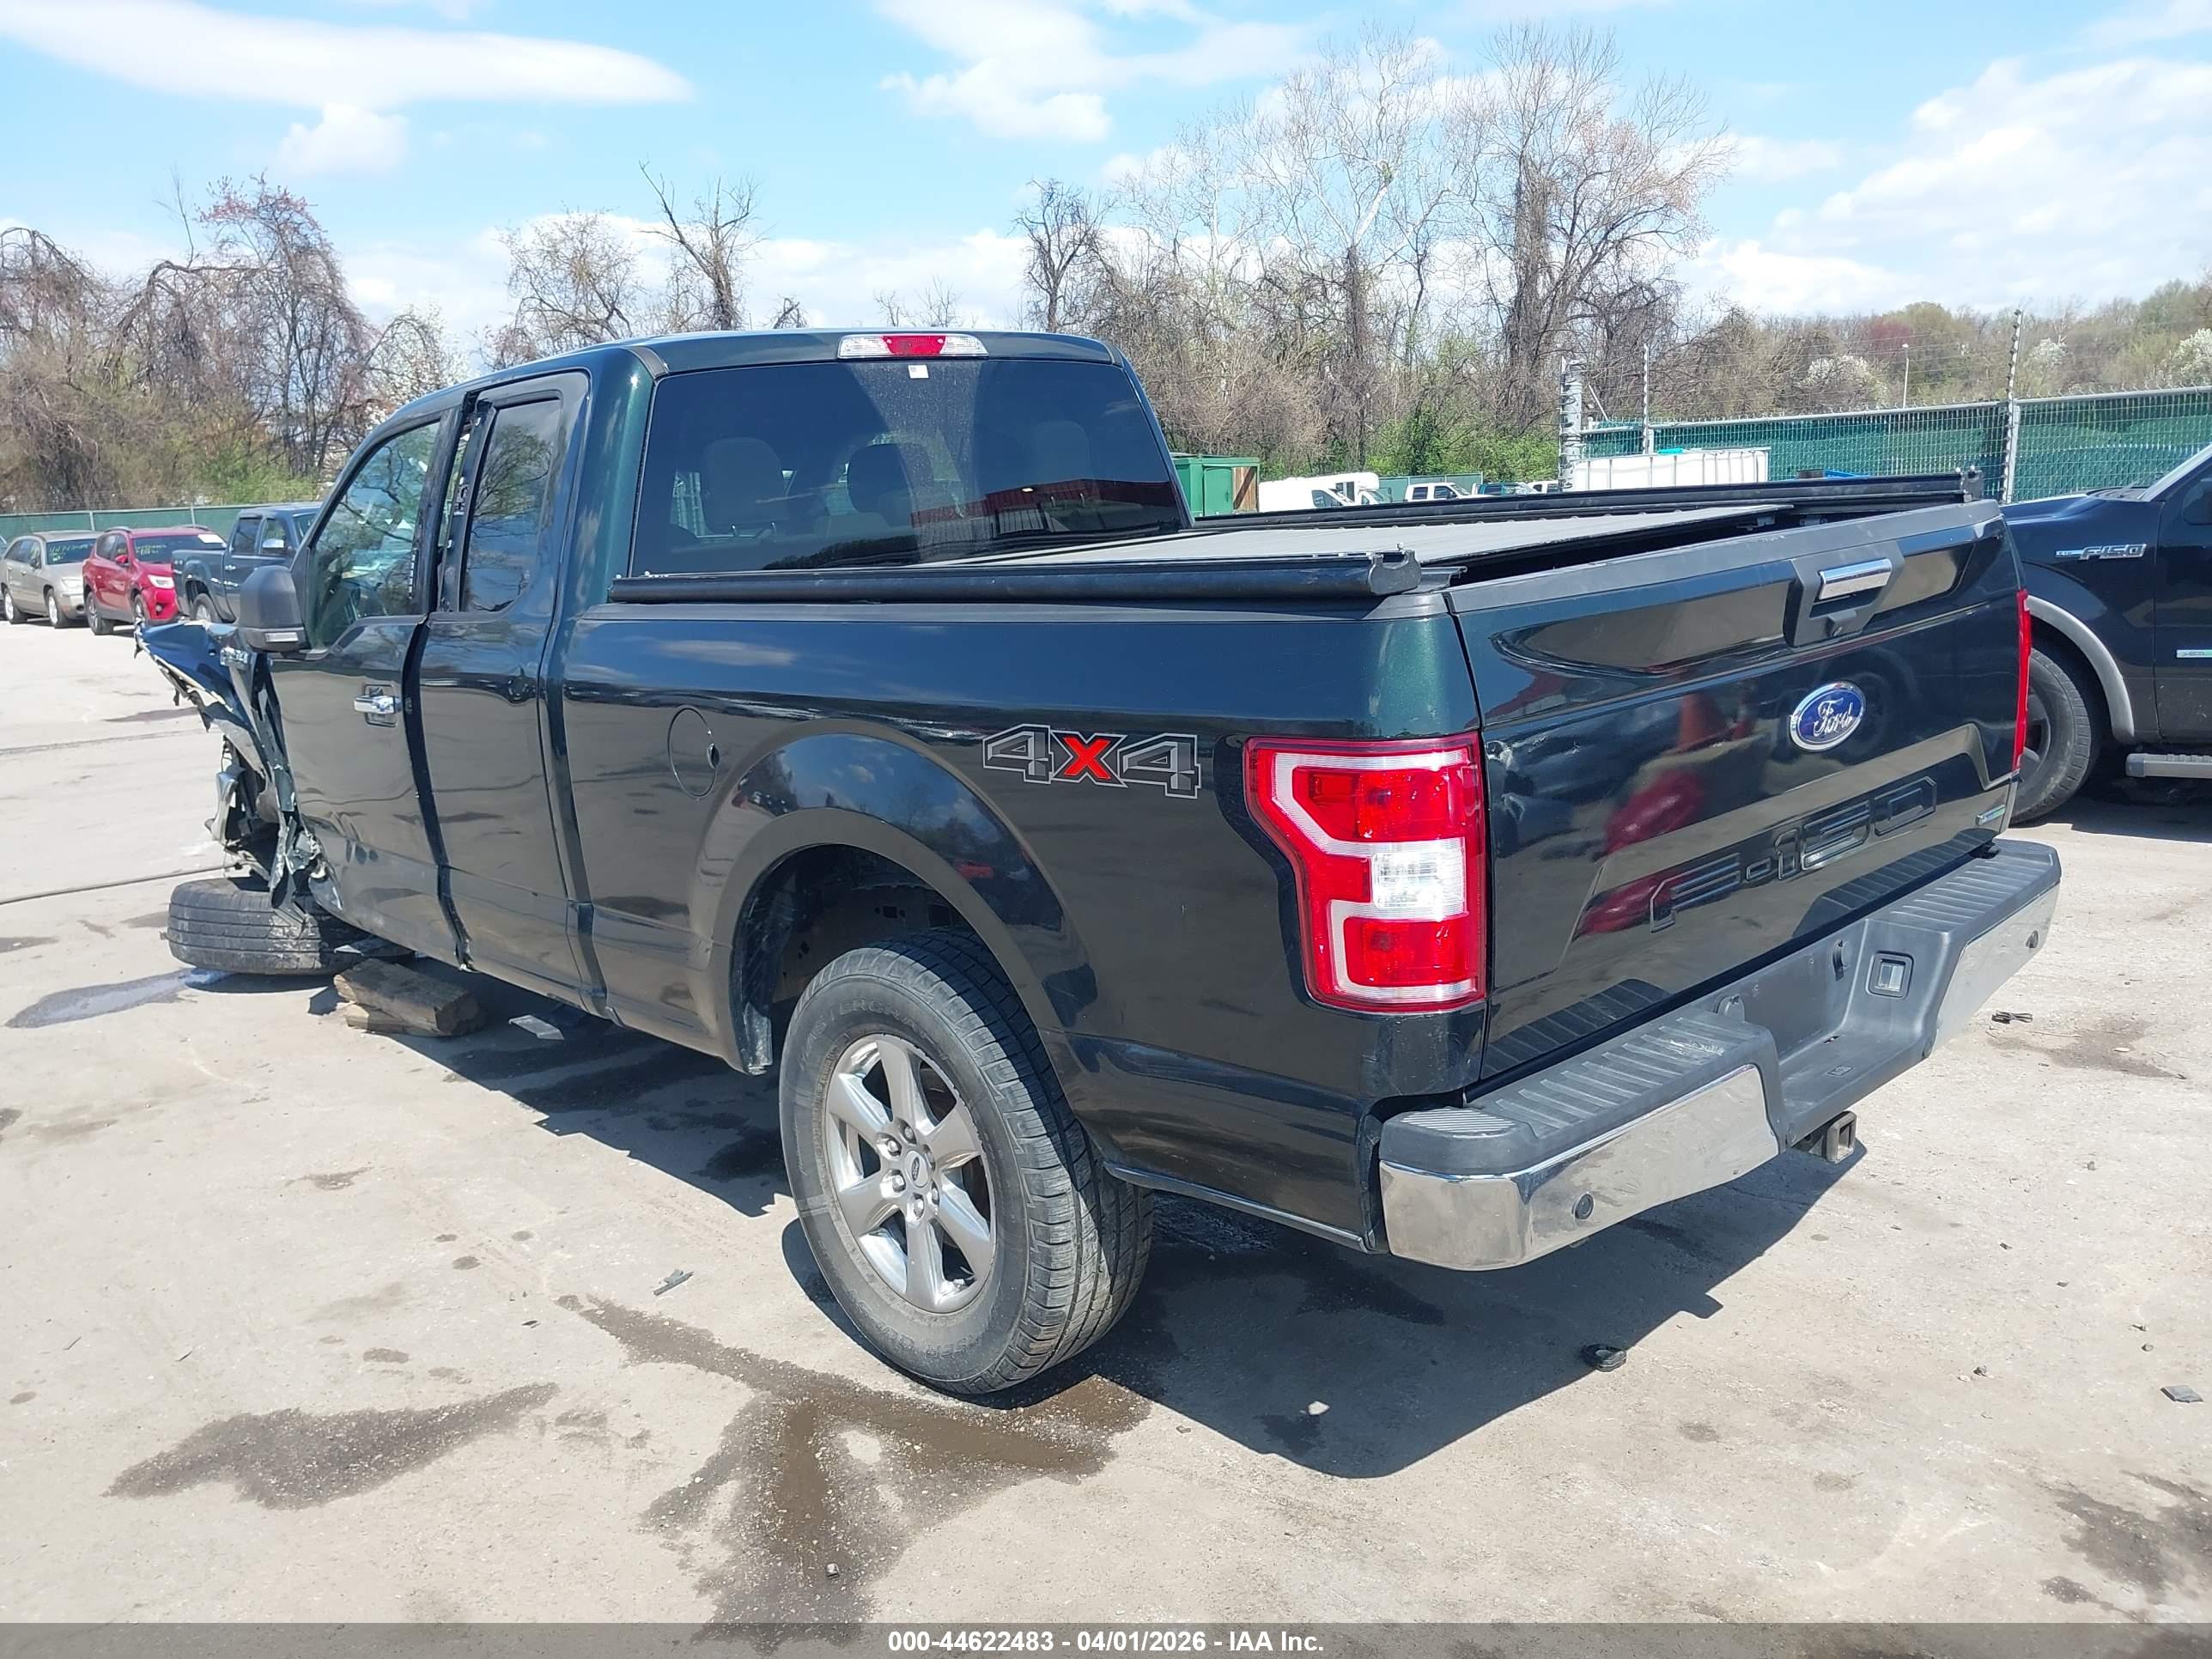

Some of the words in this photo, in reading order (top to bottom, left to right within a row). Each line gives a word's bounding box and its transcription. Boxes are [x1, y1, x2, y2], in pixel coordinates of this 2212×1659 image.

[2079, 544, 2147, 560] F-150
[1813, 697, 1854, 738] Ford
[1649, 775, 1937, 934] F-150
